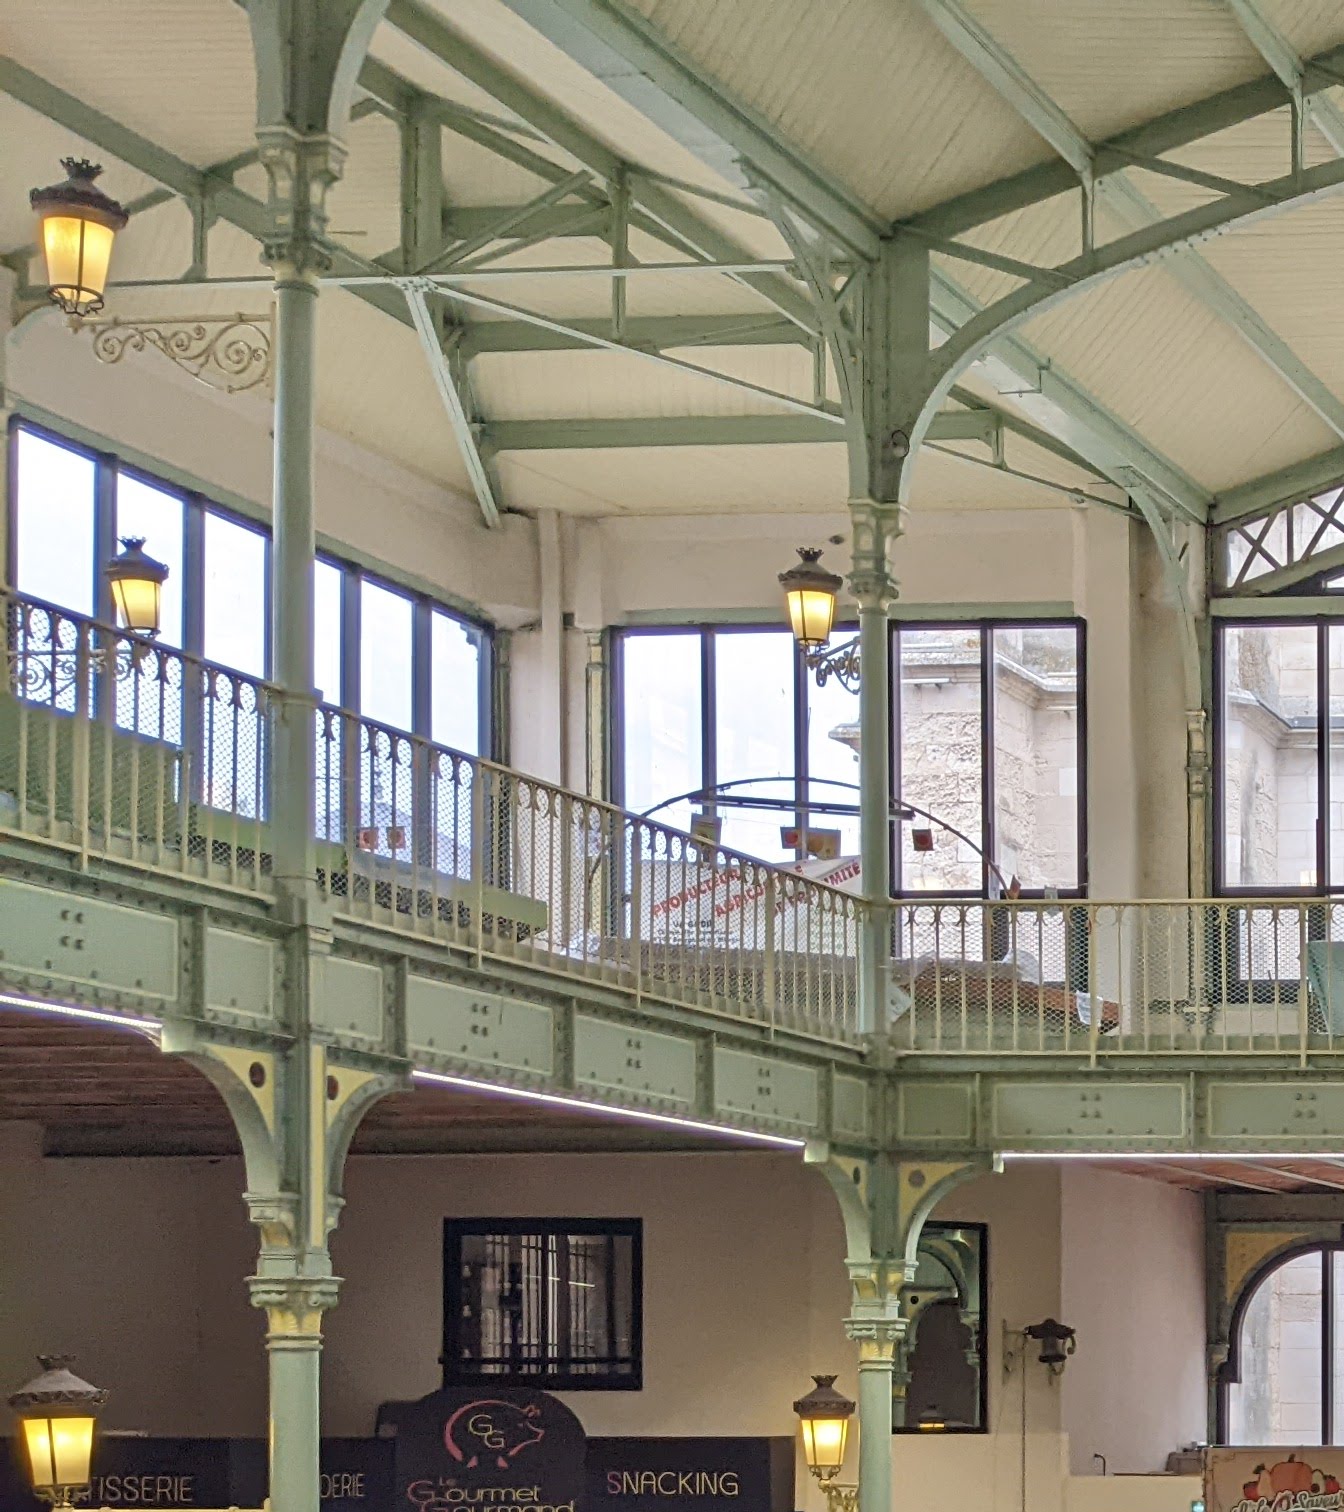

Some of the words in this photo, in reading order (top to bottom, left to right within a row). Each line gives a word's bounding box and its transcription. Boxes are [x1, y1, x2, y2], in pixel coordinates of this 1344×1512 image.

[88, 1475, 194, 1502] TISSERIE
[406, 1480, 542, 1504] Gourmet
[606, 1471, 740, 1496] SNACKING
